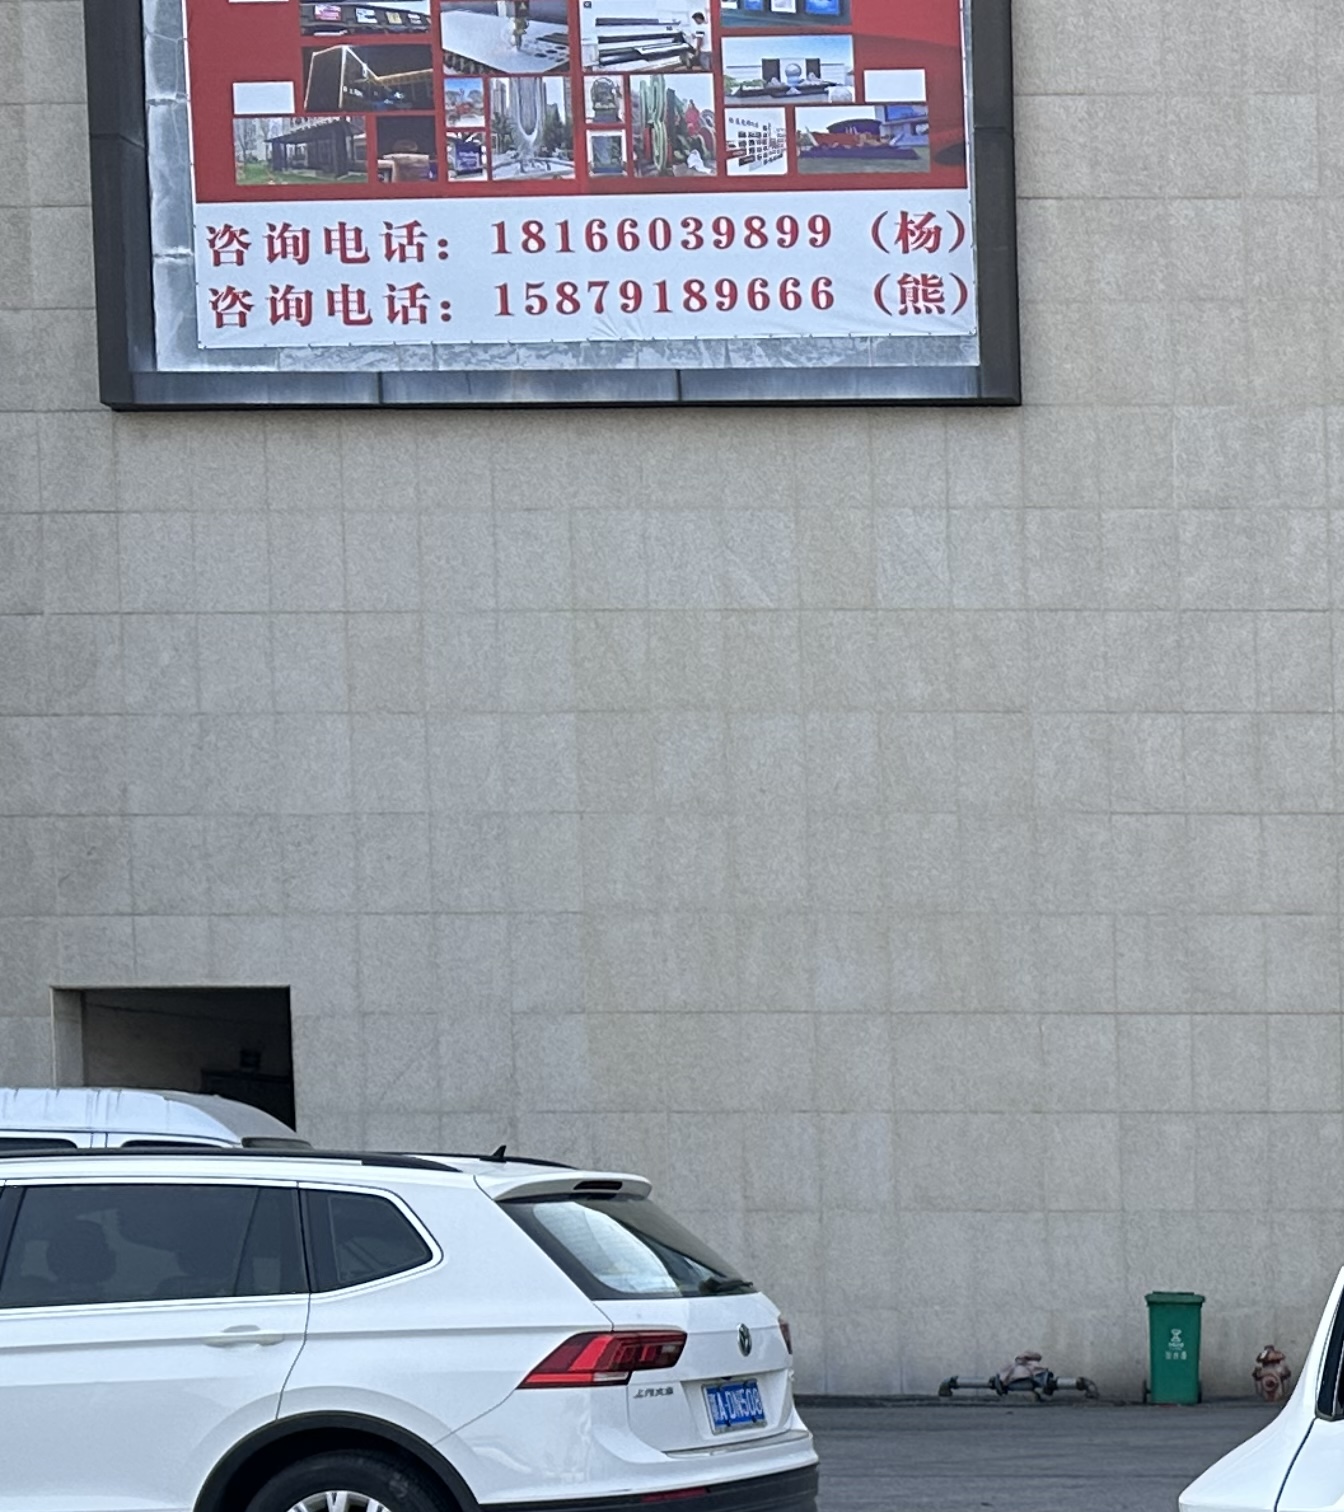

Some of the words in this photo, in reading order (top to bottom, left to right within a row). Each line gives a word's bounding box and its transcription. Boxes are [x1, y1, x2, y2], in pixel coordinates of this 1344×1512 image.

[206, 220, 449, 267] 咨询电话：
[491, 214, 832, 254] 18166039899
[871, 210, 965, 254] （杨）
[209, 282, 452, 328] 咨询电话：
[494, 276, 834, 316] 15879189666
[873, 272, 968, 316] （熊）
